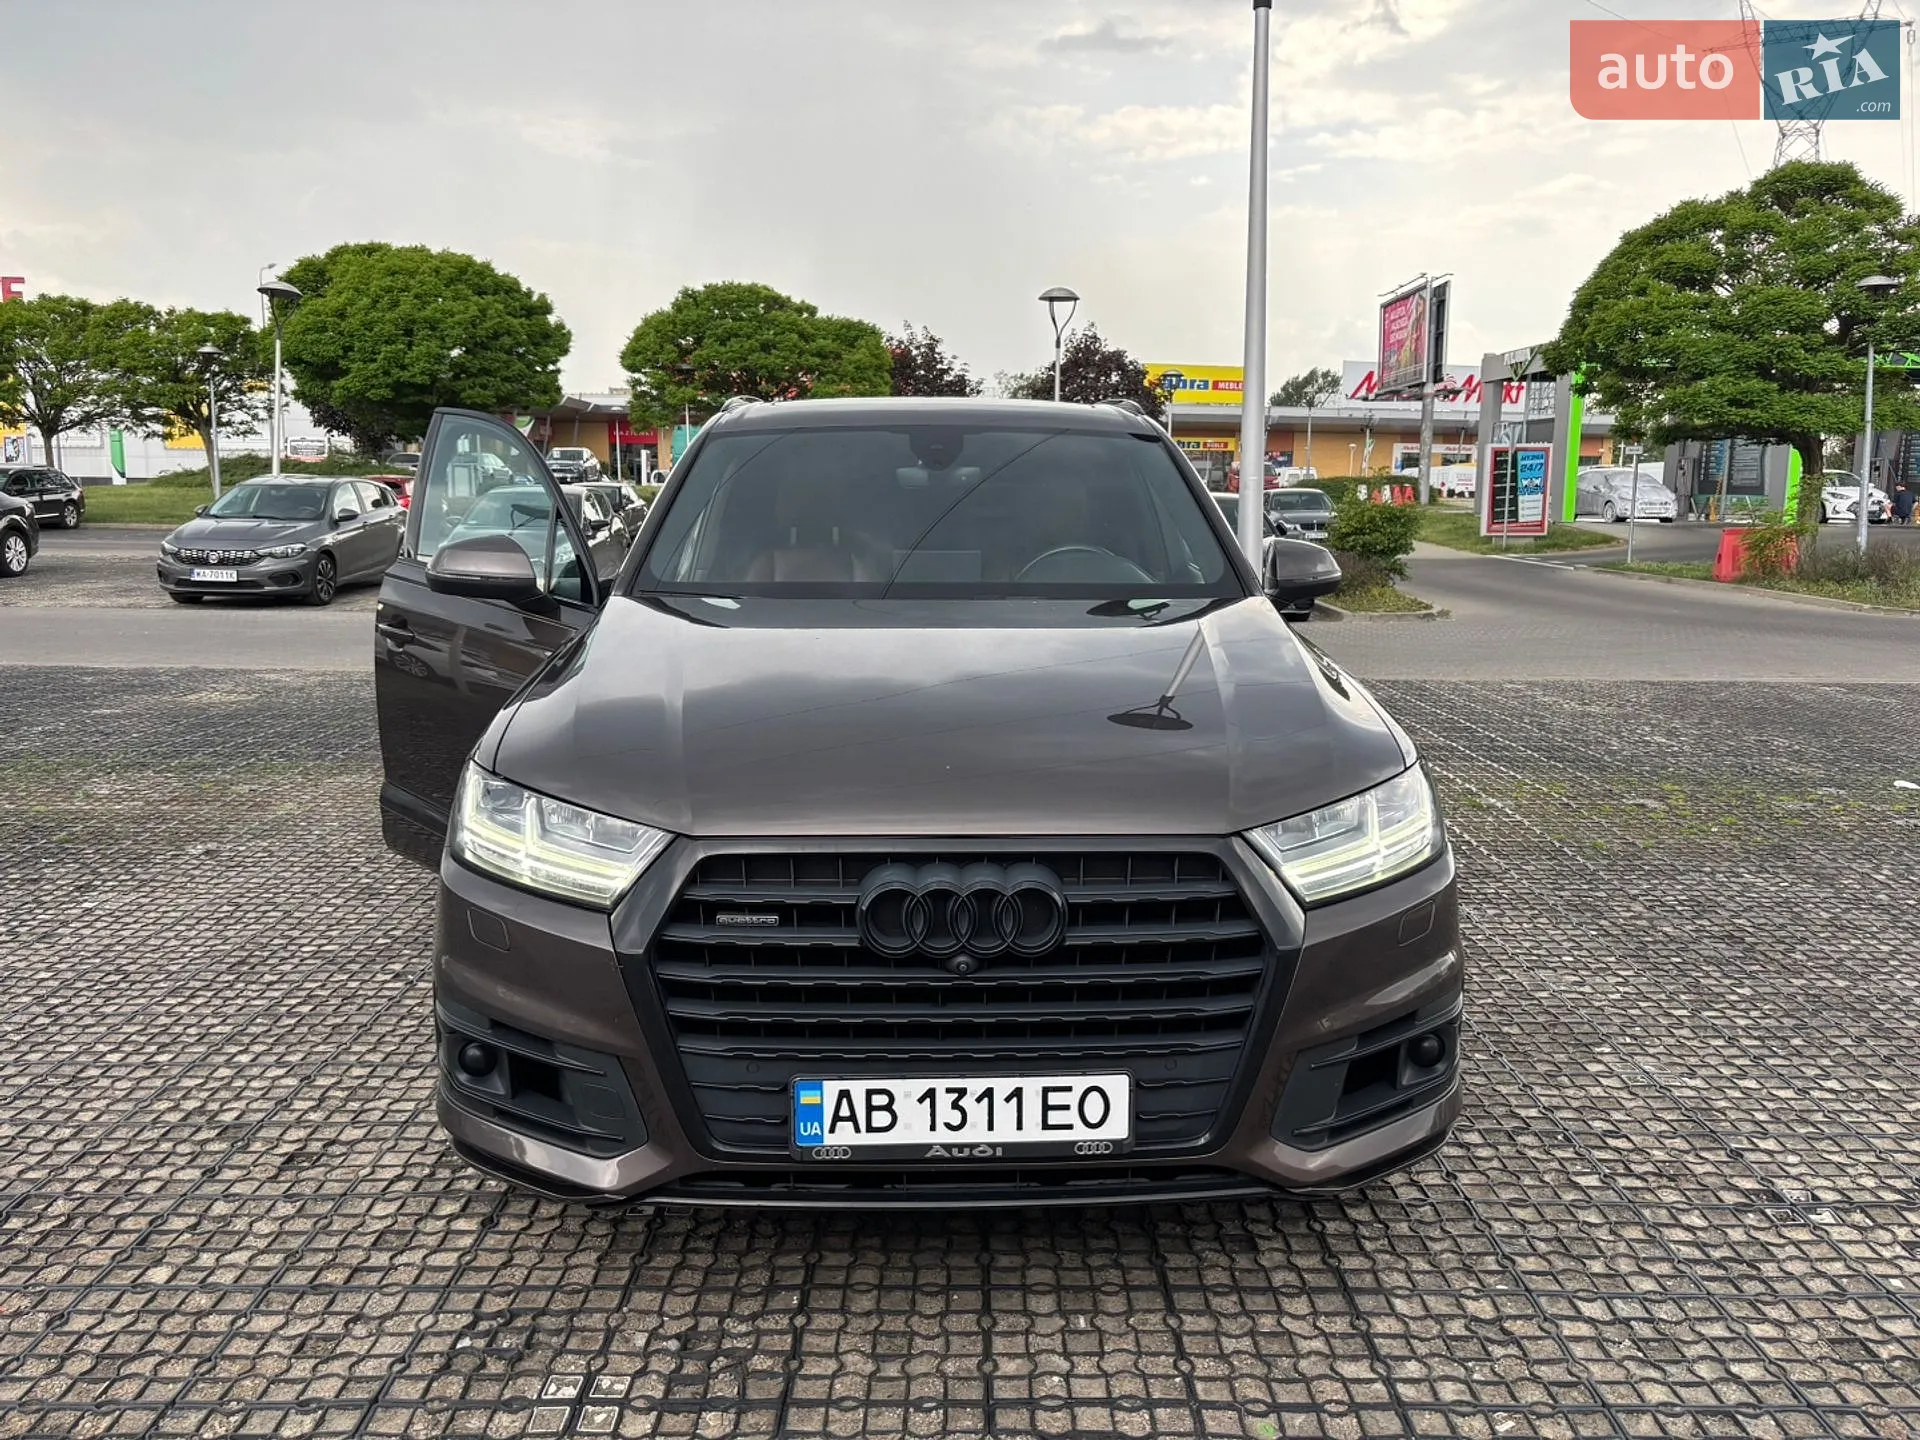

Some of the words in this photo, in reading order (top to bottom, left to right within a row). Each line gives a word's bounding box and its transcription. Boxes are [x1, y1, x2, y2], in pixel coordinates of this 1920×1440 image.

[1452, 373, 1525, 404] Mkt
[1520, 462, 1544, 473] 24/7
[827, 1088, 899, 1136] AB
[917, 1086, 1024, 1133] 1311
[800, 1123, 822, 1136] UA
[924, 1144, 1003, 1158] Audi
